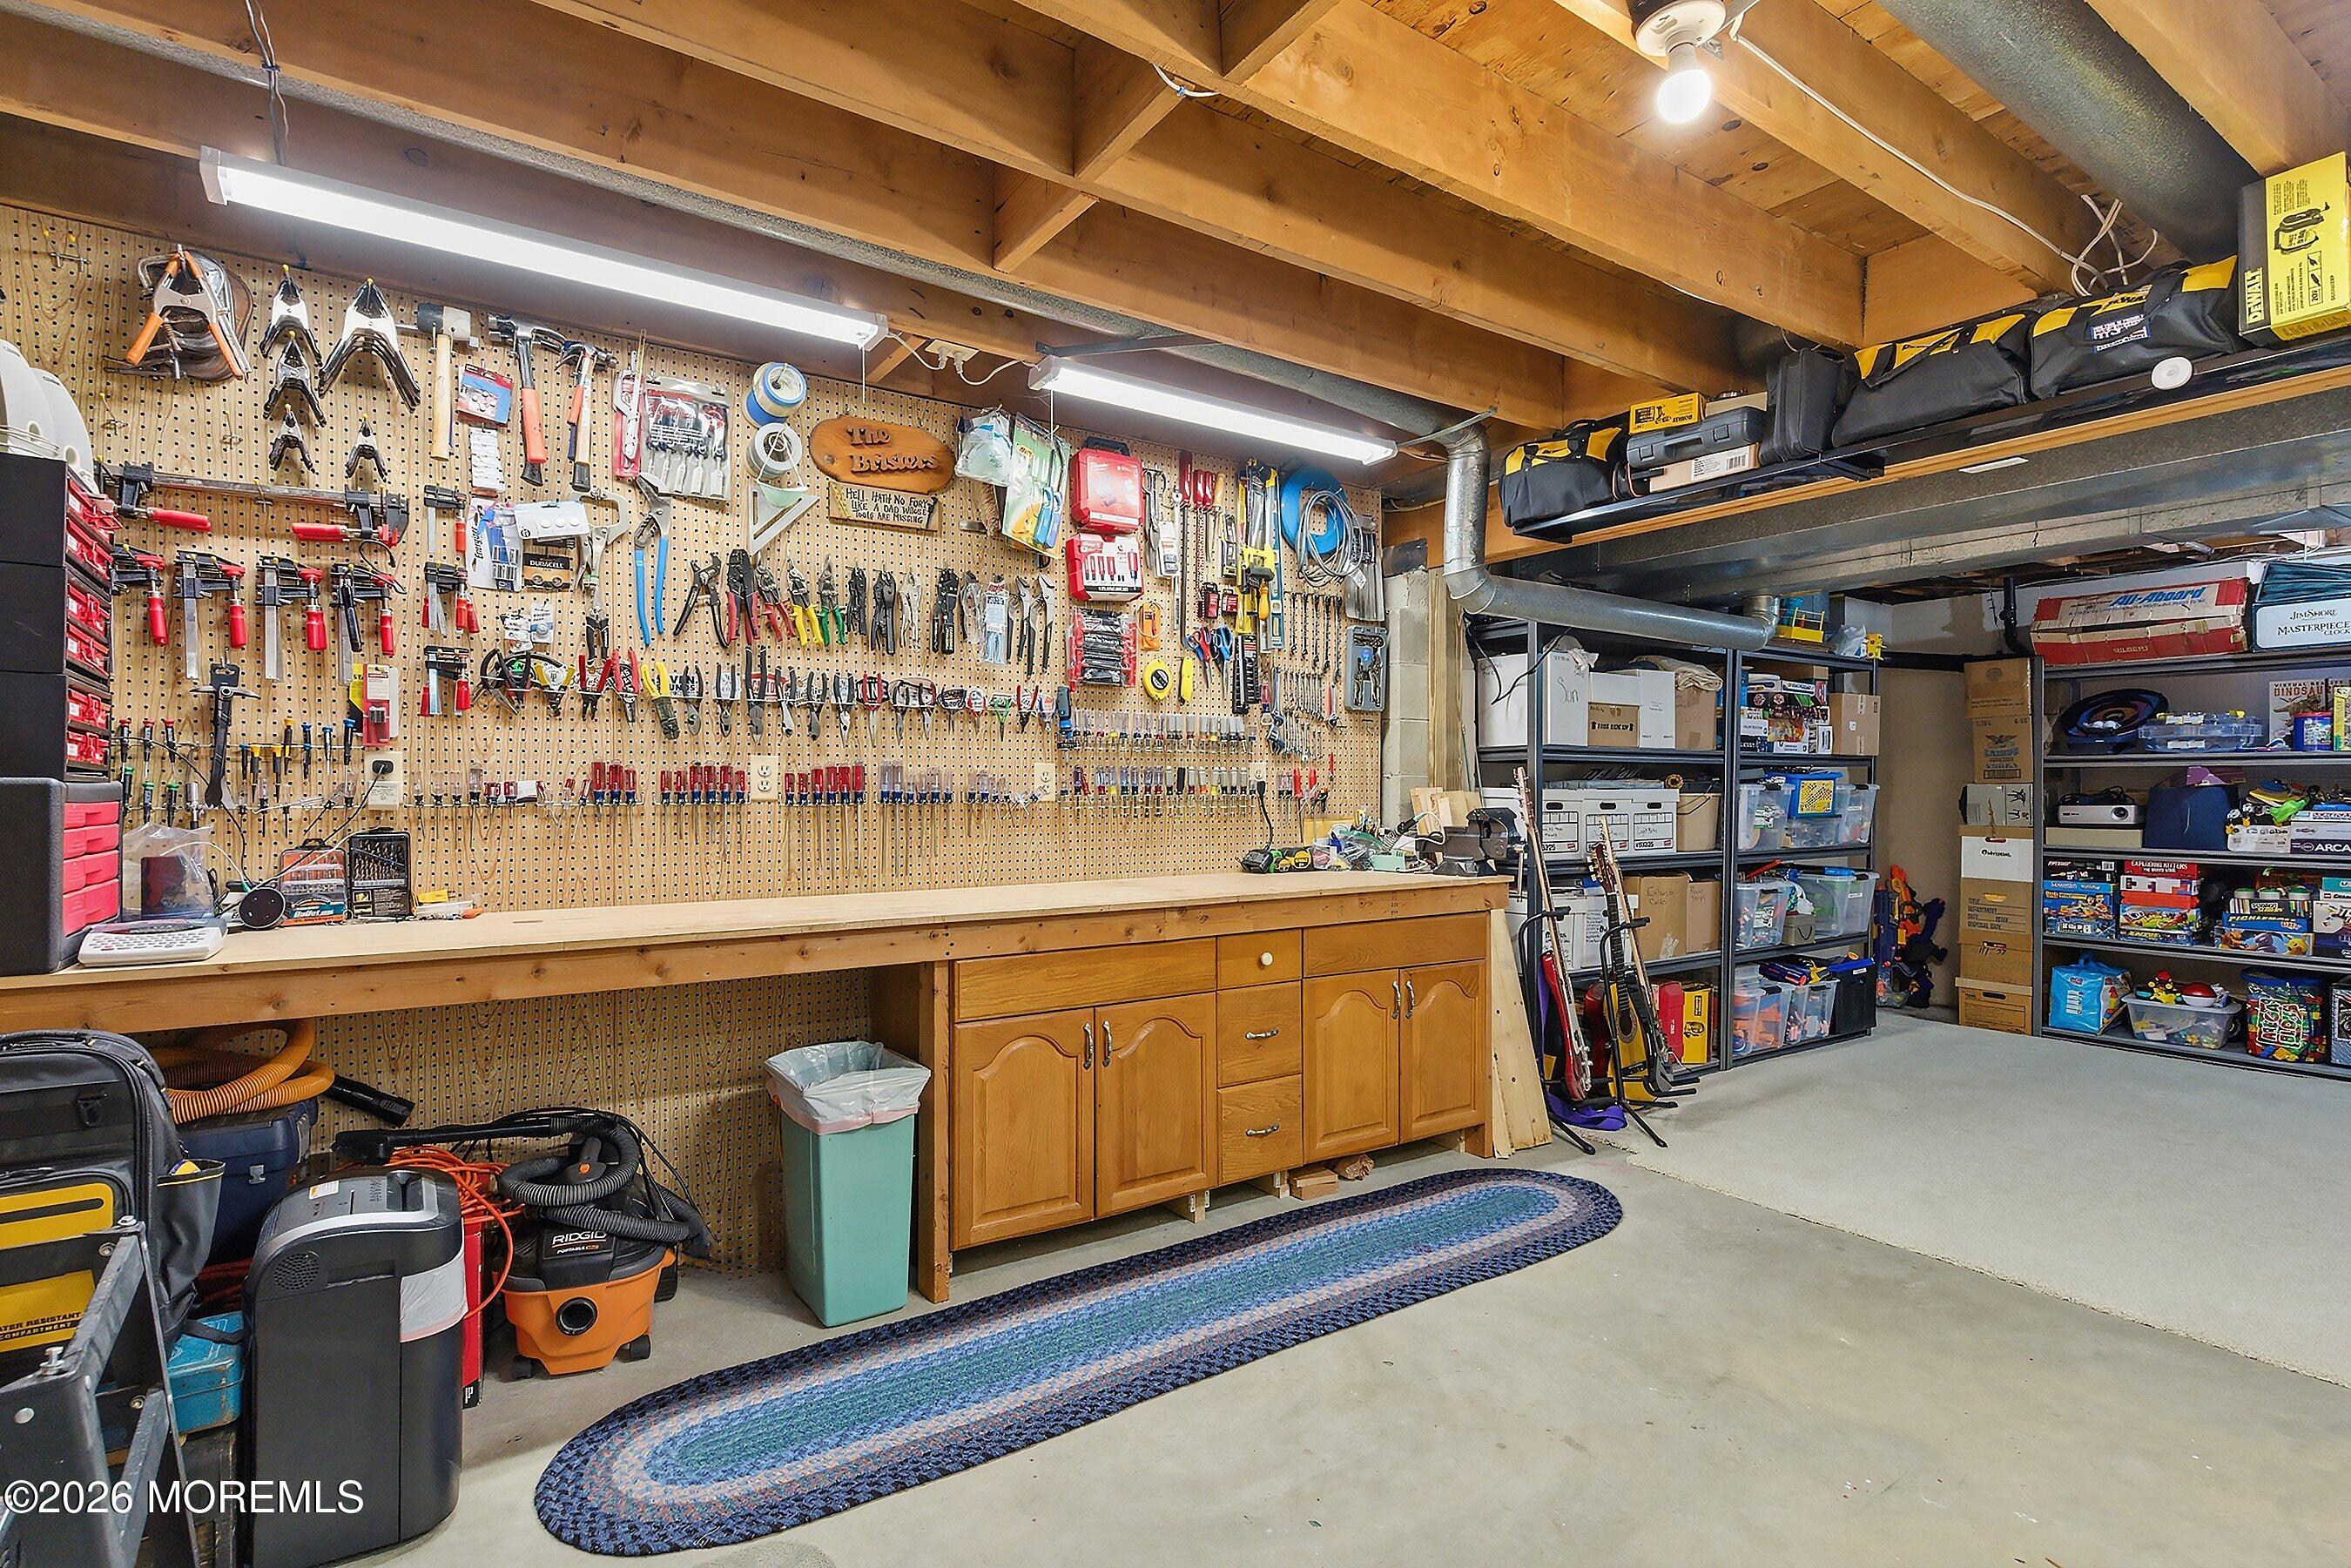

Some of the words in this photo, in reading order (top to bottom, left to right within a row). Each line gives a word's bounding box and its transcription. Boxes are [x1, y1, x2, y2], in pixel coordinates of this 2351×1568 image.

[2245, 267, 2264, 324] DEWALT
[845, 427, 890, 447] The
[872, 491, 892, 504] HATH
[893, 495, 906, 506] NO
[851, 500, 868, 512] LIKE
[872, 504, 879, 513] A
[884, 504, 899, 514] DAD
[902, 505, 927, 516] WHOSE
[877, 511, 890, 522] ARE
[893, 512, 924, 524] MISSING
[529, 560, 564, 569] DURACELL
[2109, 586, 2209, 607] All-Aboard
[2277, 621, 2351, 636] MASTERPIECE
[2323, 628, 2351, 636] CLOCK
[552, 1230, 608, 1245] RIDGID
[26, 1312, 81, 1326] RESISTANT
[0, 1322, 71, 1340] COMPARTMENT
